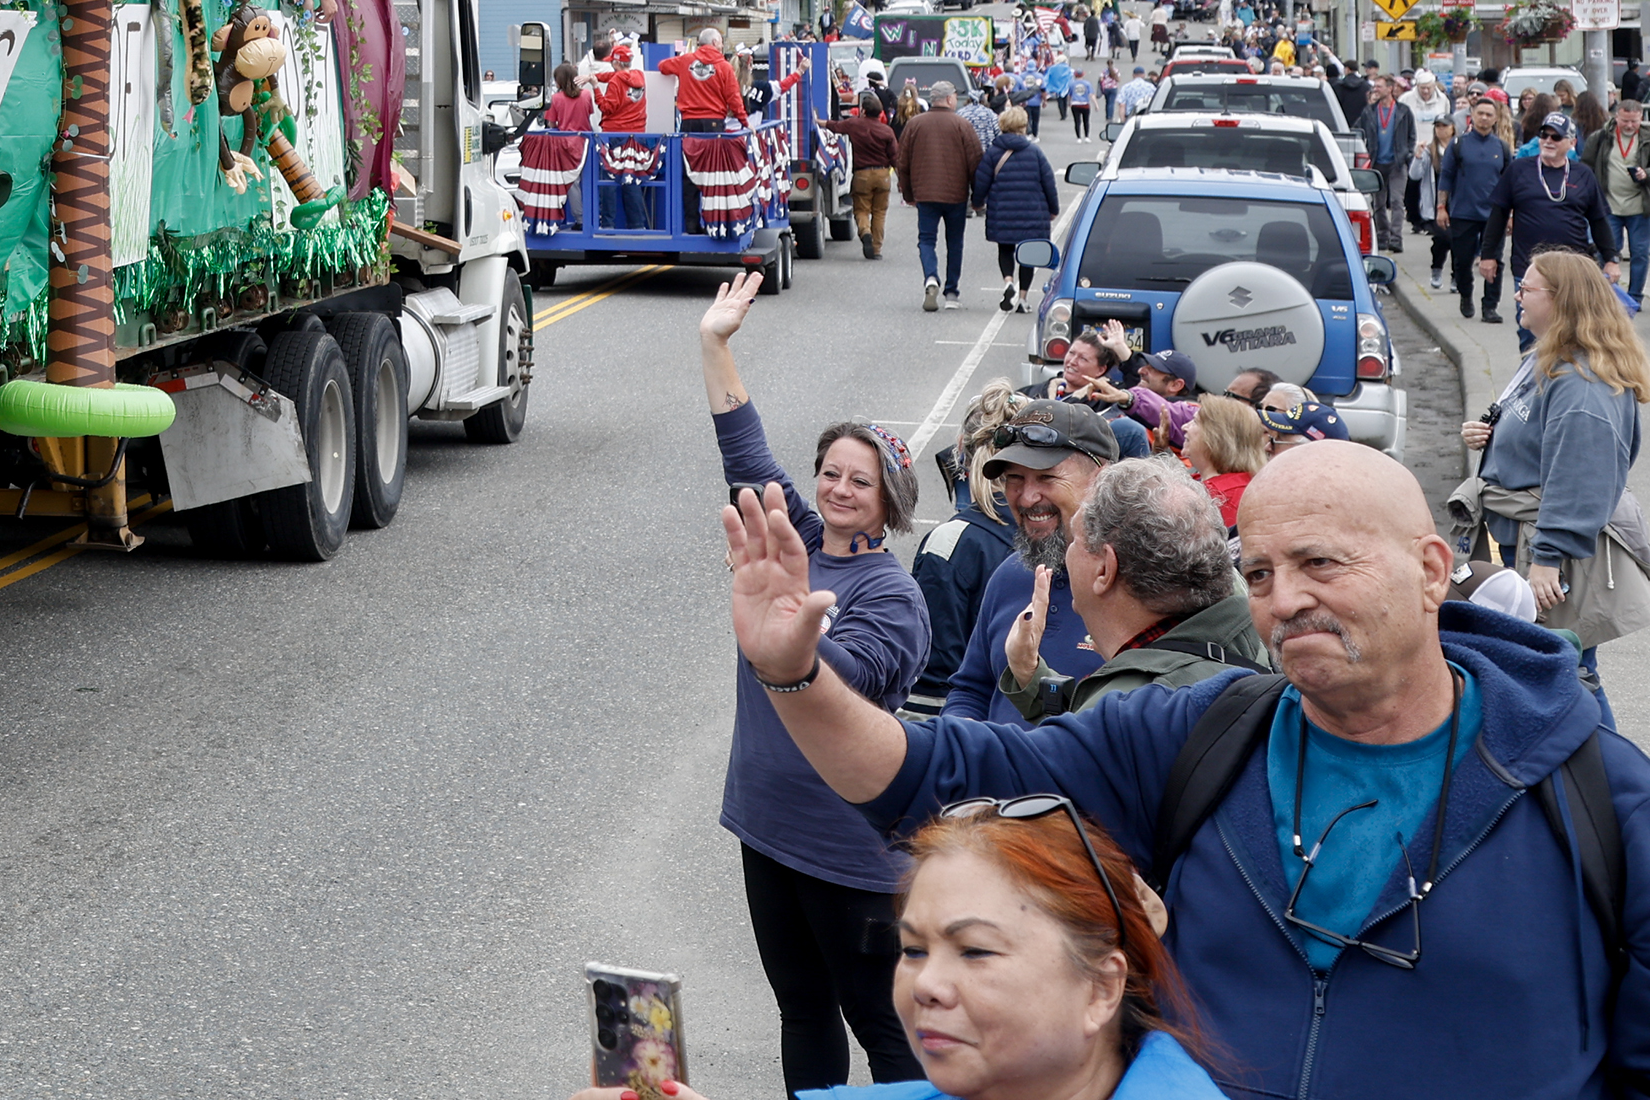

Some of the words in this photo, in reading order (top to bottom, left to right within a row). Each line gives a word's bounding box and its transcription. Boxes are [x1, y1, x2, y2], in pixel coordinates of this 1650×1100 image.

[949, 20, 984, 38] $5K
[880, 23, 938, 57] WIN
[946, 36, 982, 56] Today
[1094, 291, 1132, 299] SUZUKI
[1331, 305, 1348, 313] V6
[1126, 333, 1143, 350] 54
[1200, 328, 1236, 348] V6
[1232, 325, 1287, 340] GRAND
[1226, 331, 1297, 353] VITARA
[1268, 420, 1293, 431] VETERAN
